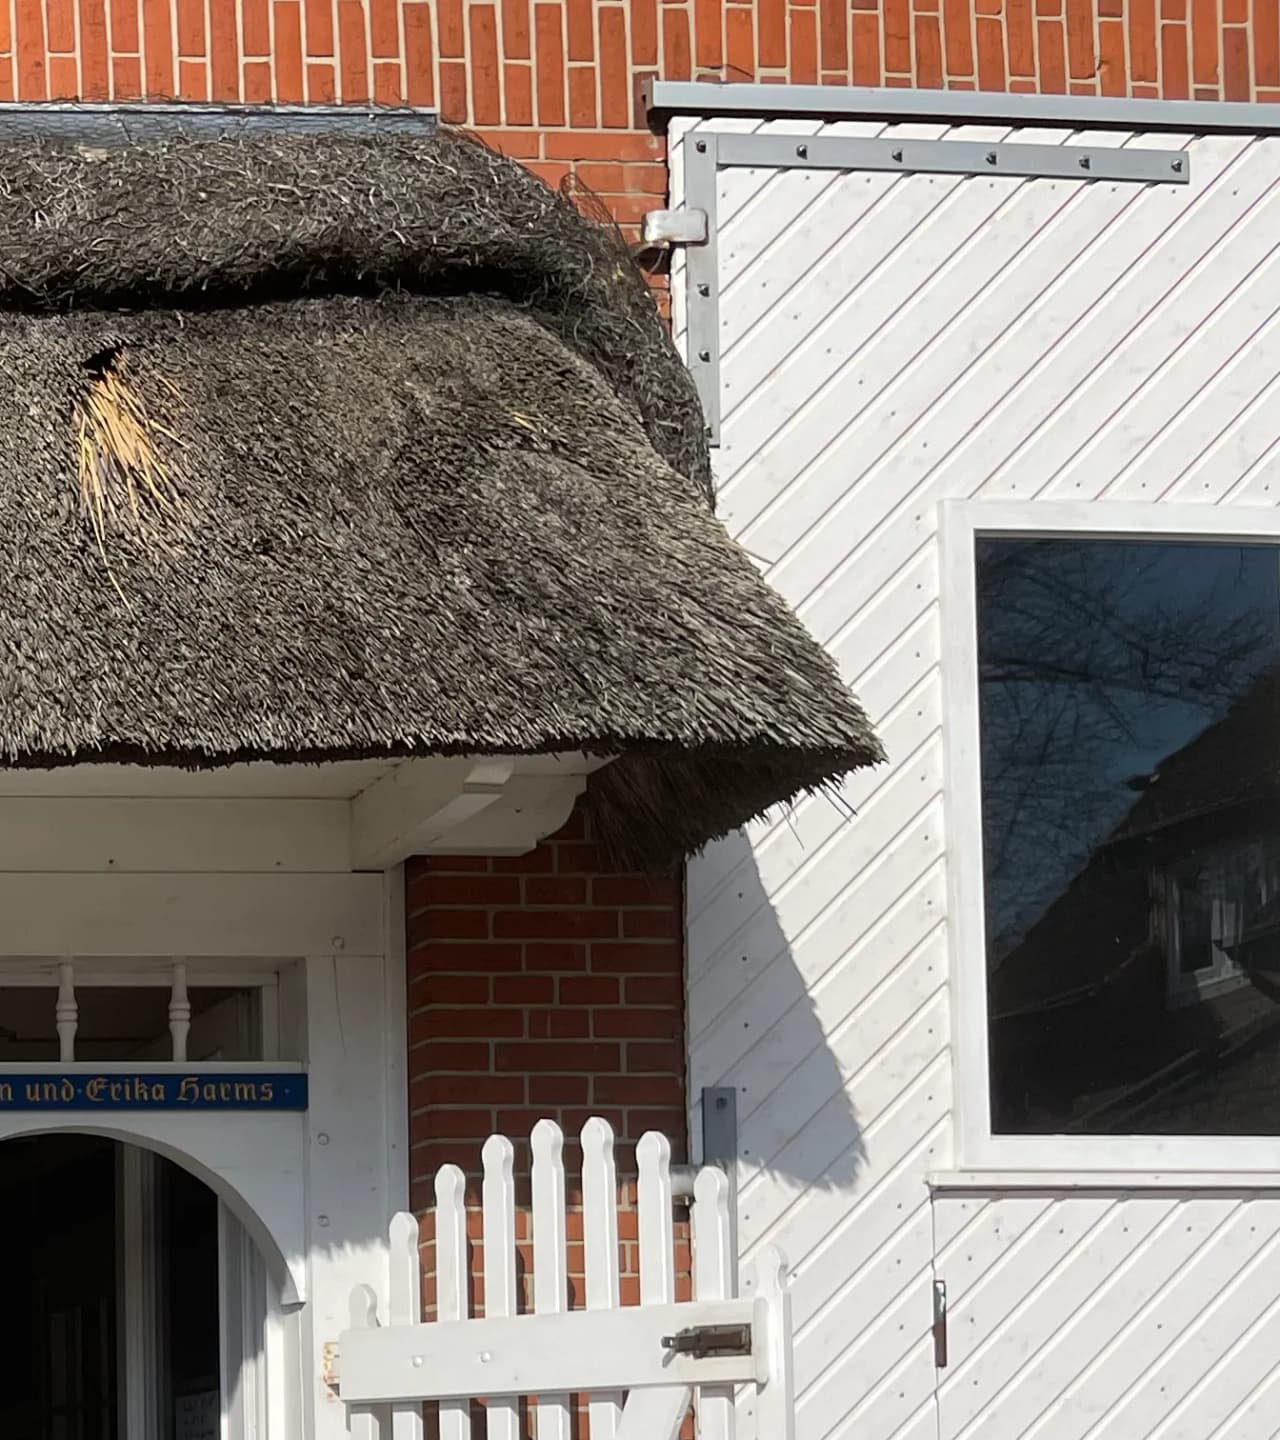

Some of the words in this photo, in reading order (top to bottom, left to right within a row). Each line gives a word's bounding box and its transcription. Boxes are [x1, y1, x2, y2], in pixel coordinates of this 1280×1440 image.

[25, 1077, 76, 1103] und
[85, 1077, 166, 1102] Erika
[176, 1077, 274, 1104] Harms
